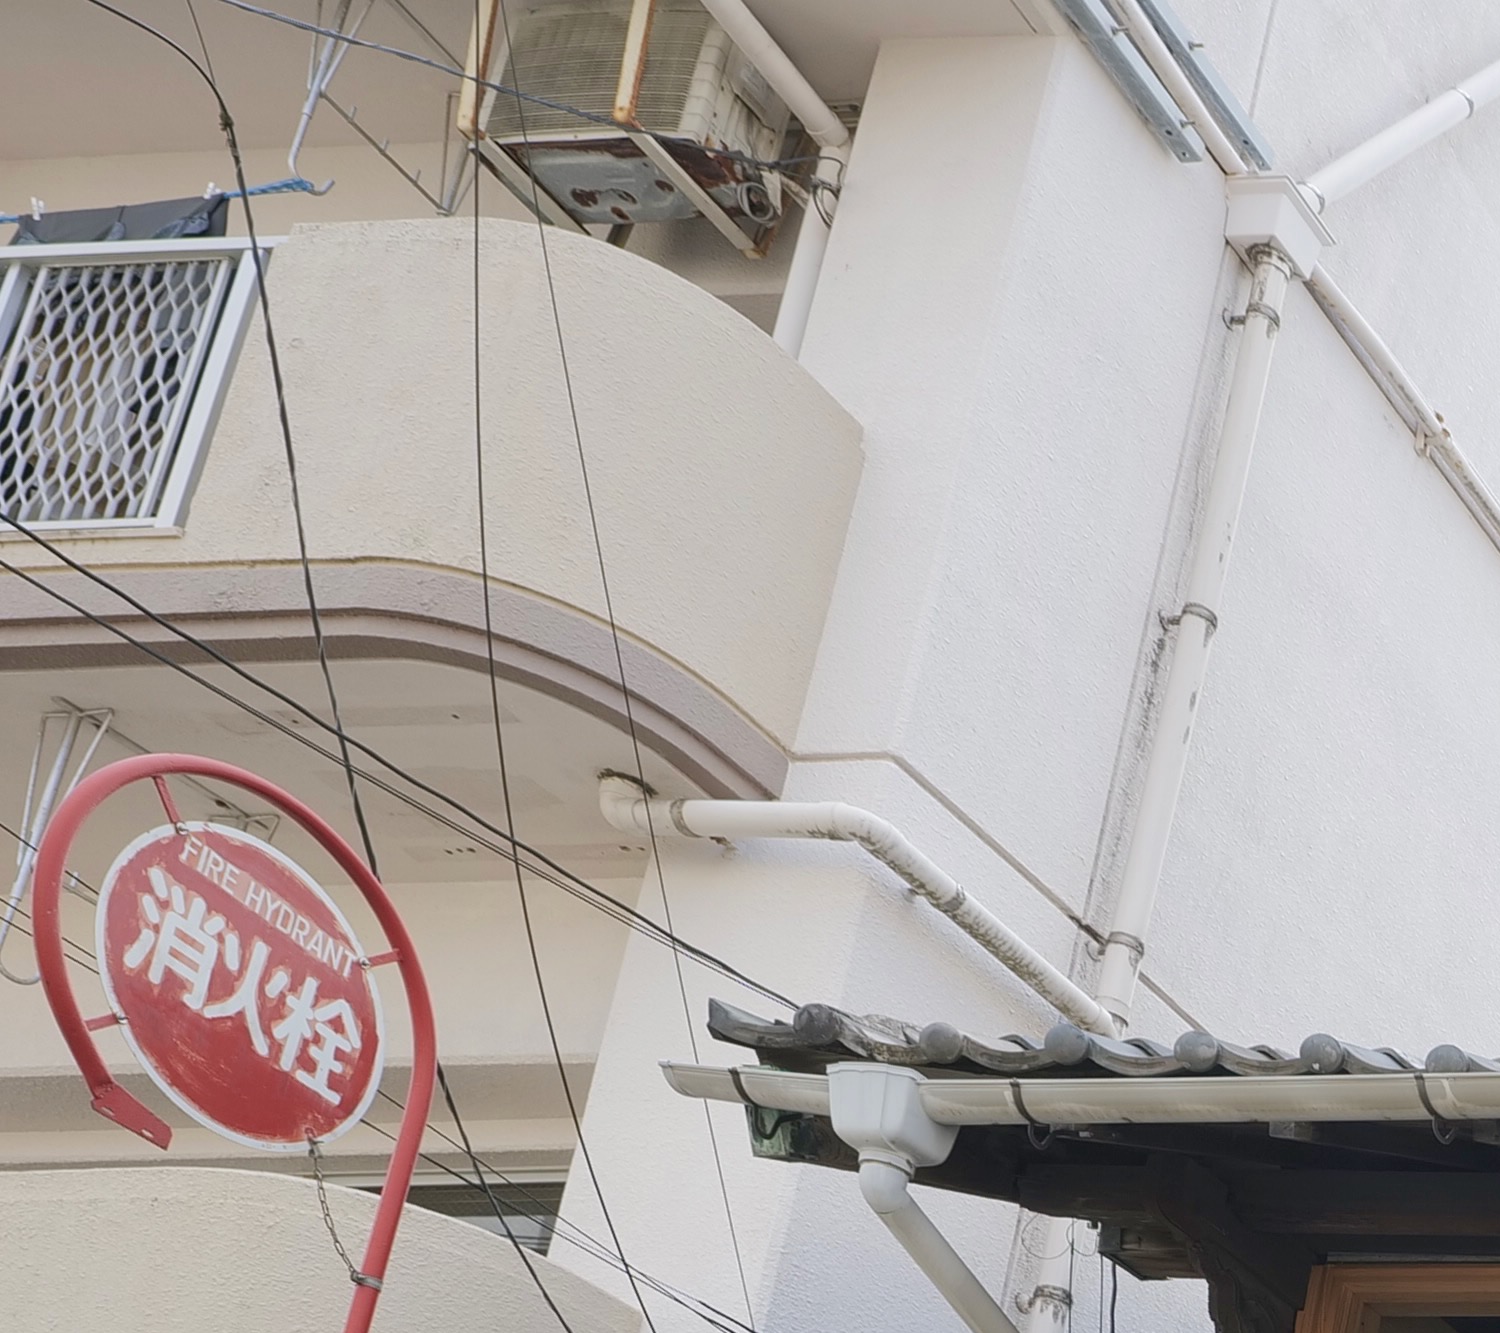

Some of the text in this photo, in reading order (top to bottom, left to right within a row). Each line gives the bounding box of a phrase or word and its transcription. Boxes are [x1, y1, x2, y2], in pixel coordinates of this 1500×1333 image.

[124, 868, 362, 1106] 消火栓
[179, 837, 357, 979] FIRE HYDRANT
